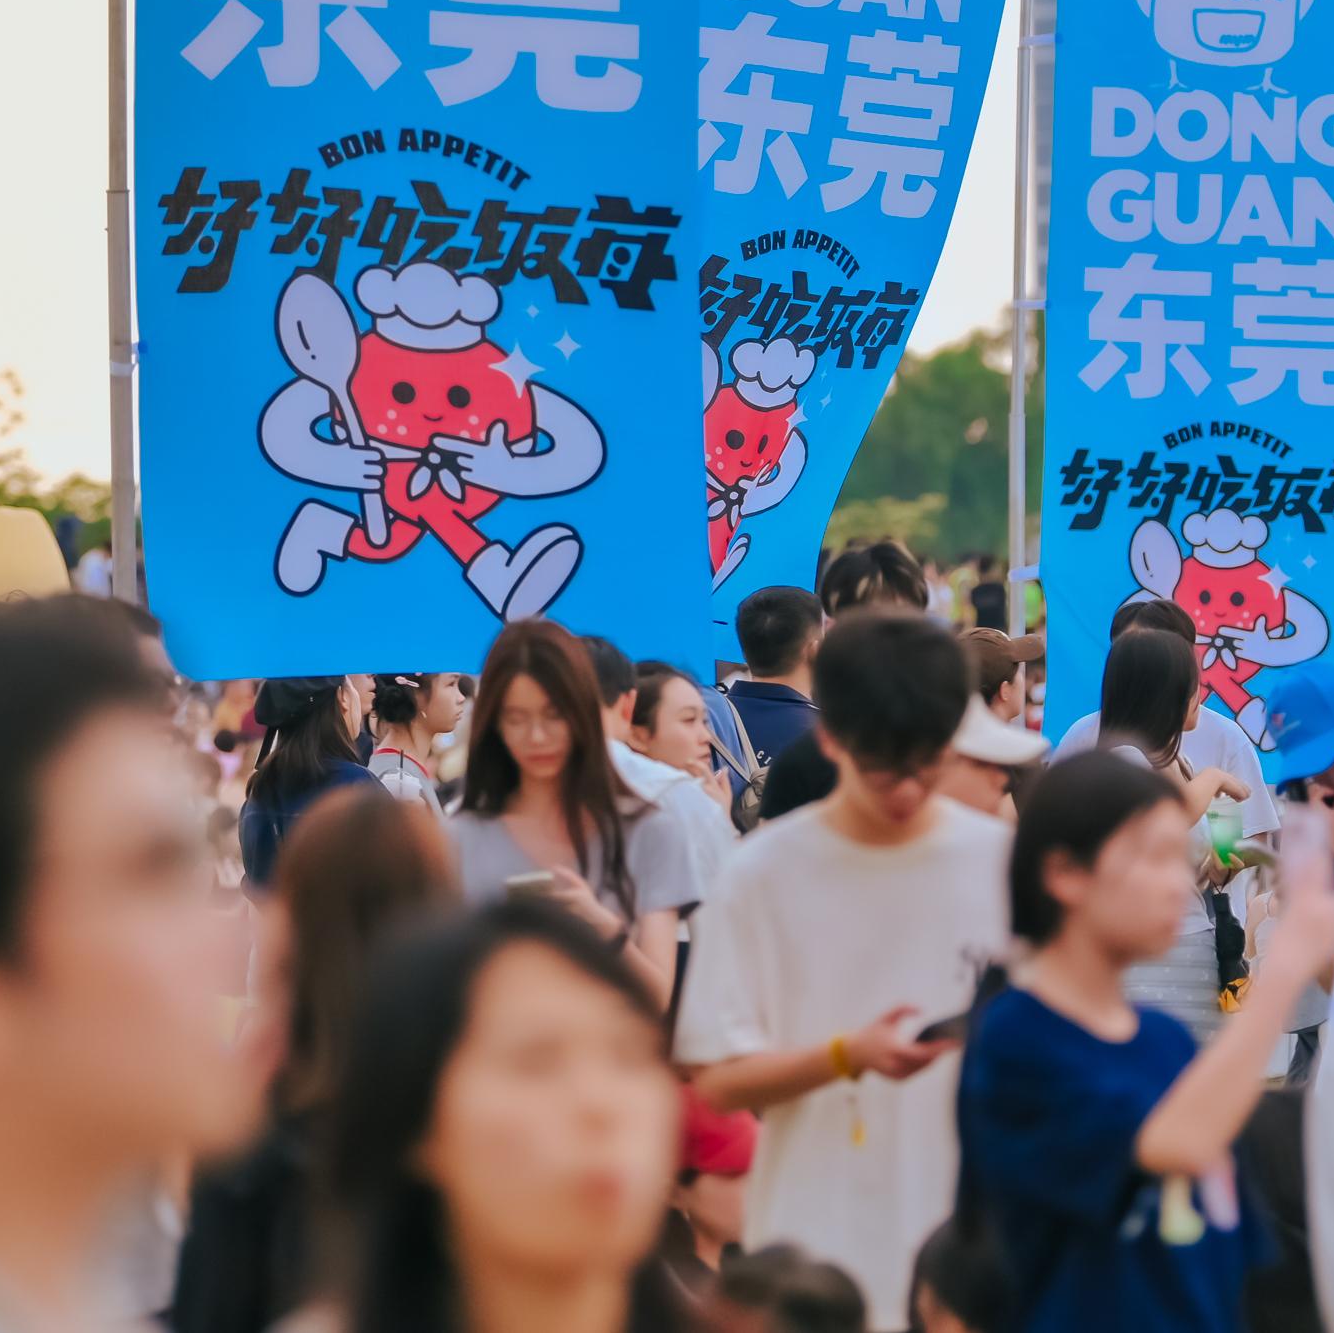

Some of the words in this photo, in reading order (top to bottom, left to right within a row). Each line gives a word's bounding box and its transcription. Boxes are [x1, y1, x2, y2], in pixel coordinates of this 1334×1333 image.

[698, 11, 962, 220] 东莞
[318, 128, 386, 169] BON
[398, 128, 531, 192] APPETIT
[740, 230, 786, 262] BON
[792, 228, 861, 280] APPETIT
[1163, 422, 1203, 450] BON
[1210, 420, 1294, 459] APPETIT
